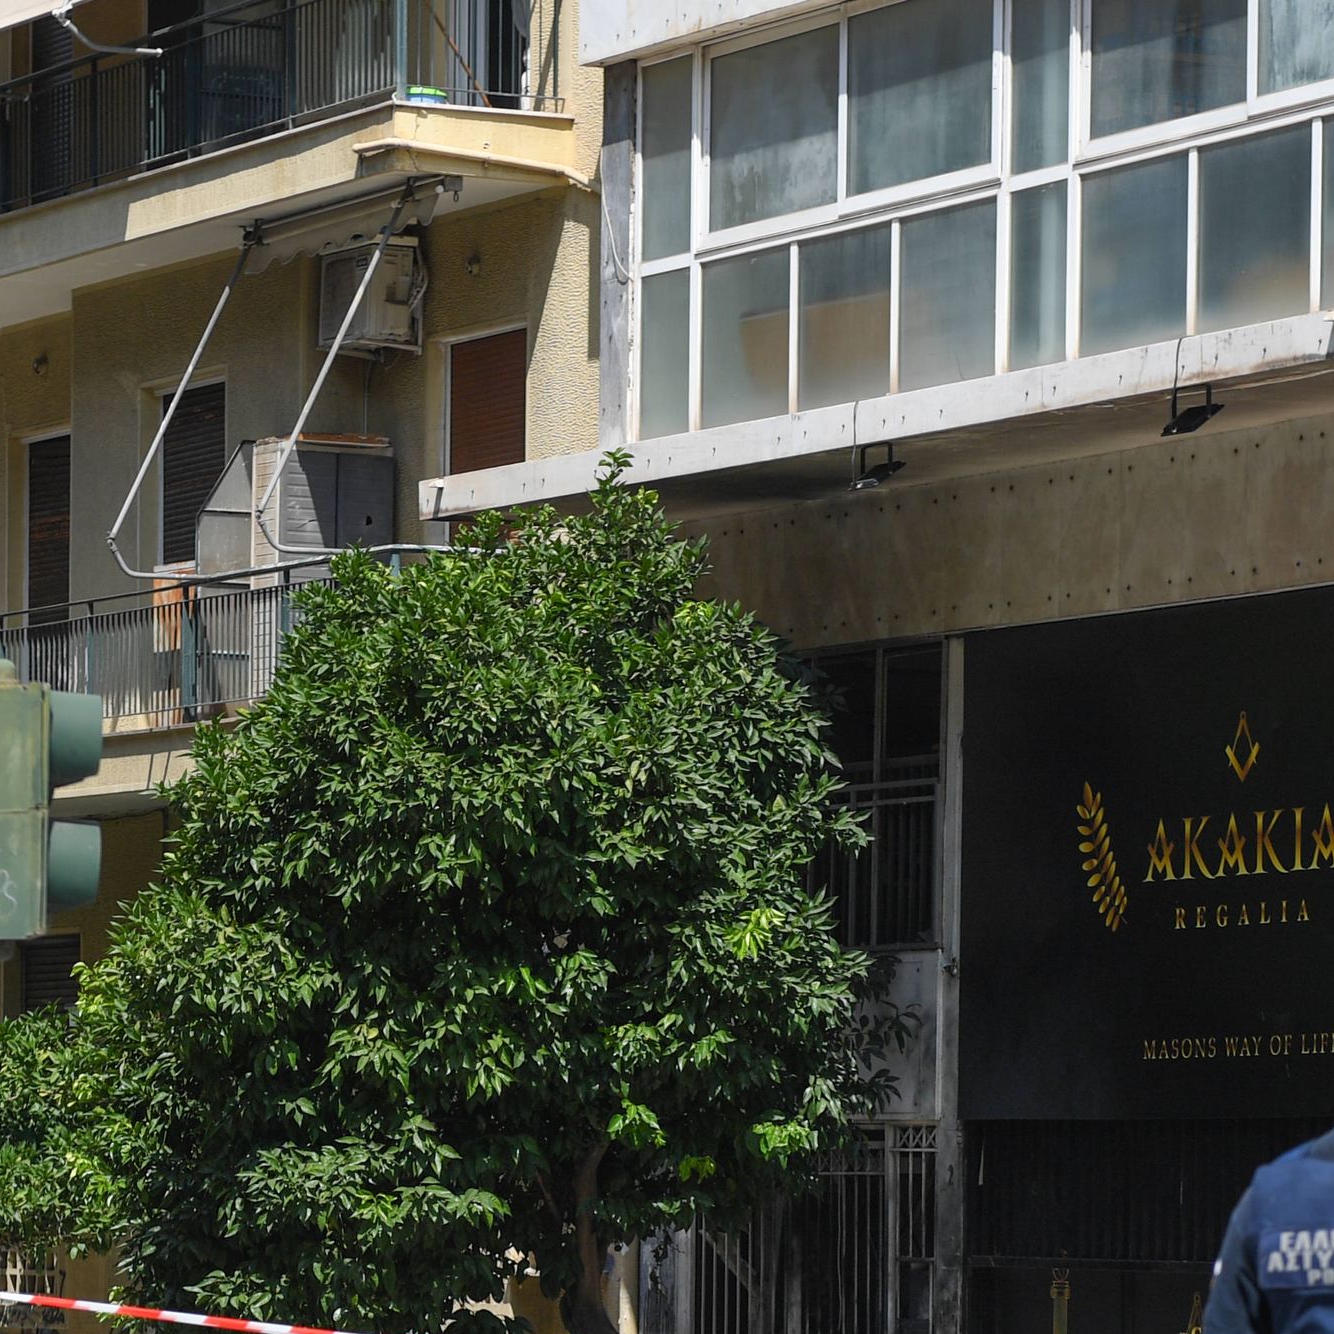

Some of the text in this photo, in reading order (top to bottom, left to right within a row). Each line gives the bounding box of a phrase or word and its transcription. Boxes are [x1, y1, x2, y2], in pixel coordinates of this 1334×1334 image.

[1174, 899, 1310, 930] REGALIA
[1143, 1037, 1217, 1060] MASONS
[1225, 1036, 1263, 1057] WAY
[1269, 1034, 1293, 1055] OF
